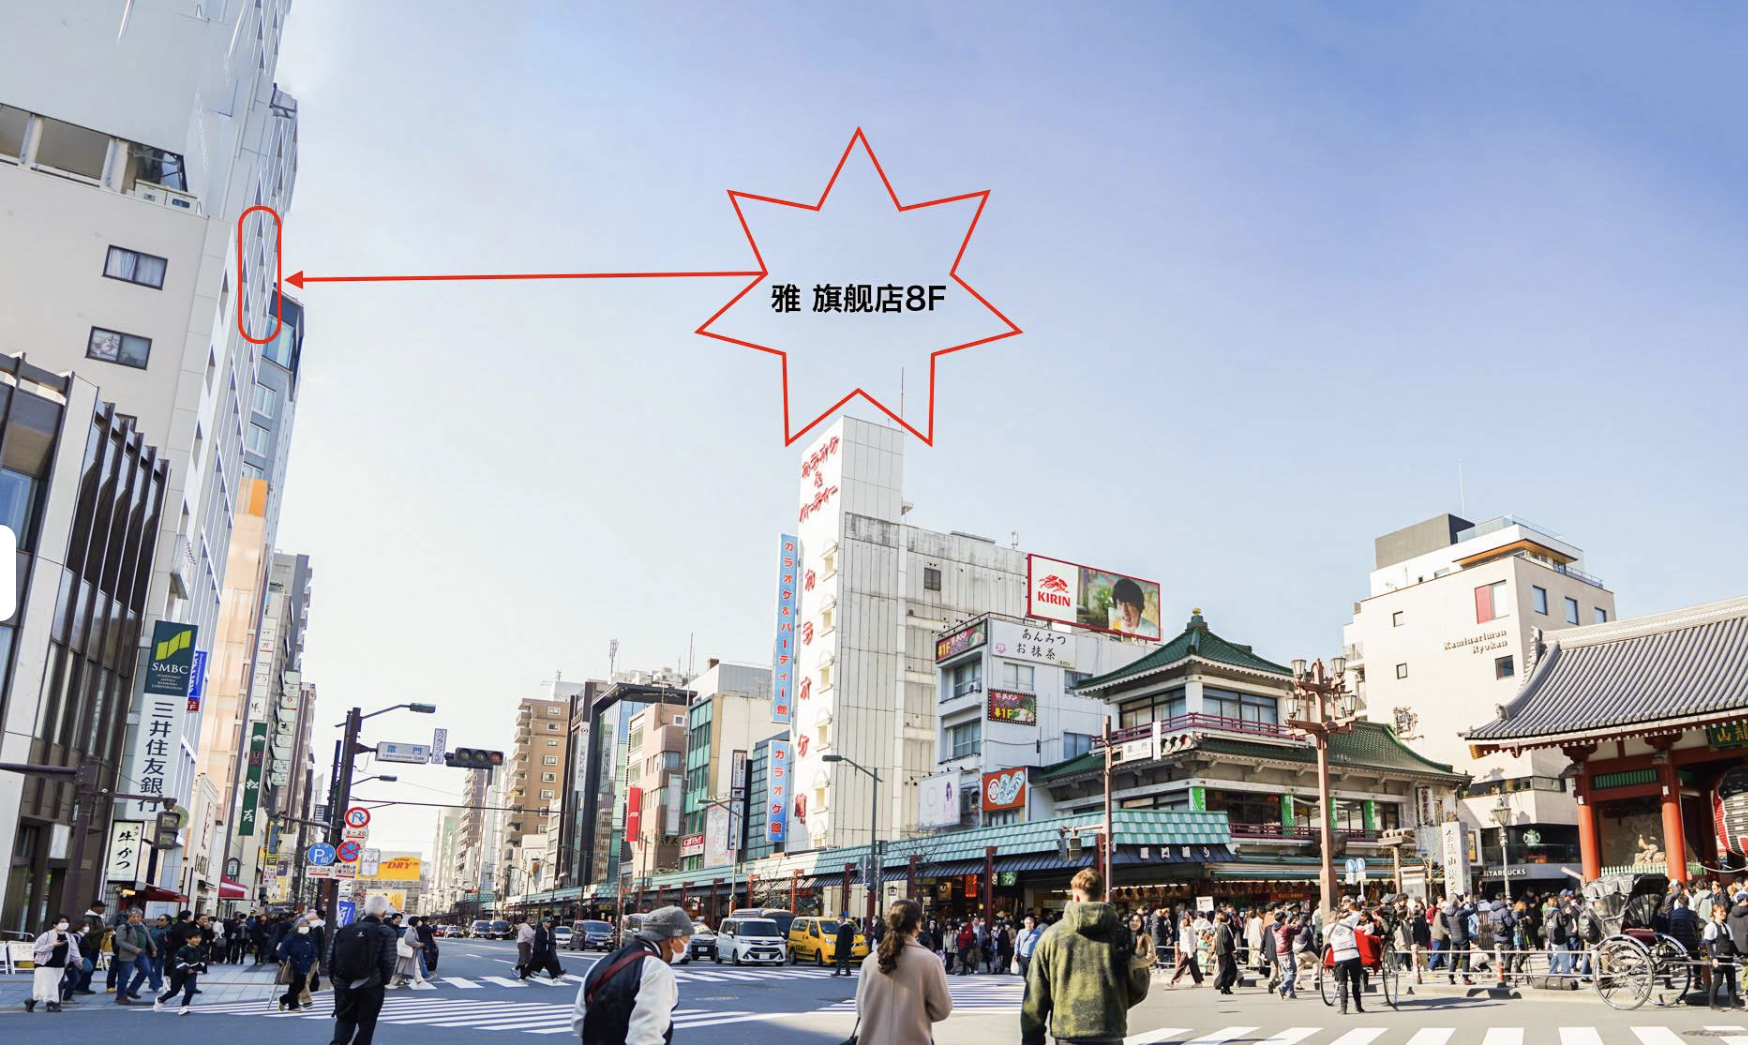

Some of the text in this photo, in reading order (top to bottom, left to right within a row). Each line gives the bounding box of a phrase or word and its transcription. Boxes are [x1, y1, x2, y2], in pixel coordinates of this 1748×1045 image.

[801, 435, 840, 479] カラオケ
[799, 485, 839, 524] パーティー
[1037, 591, 1071, 608] KIRIN
[1022, 628, 1067, 645] あんみつ
[1444, 630, 1508, 650] Kaminarimon
[1017, 642, 1056, 660] お抹茶
[1472, 640, 1509, 654] Ryokan
[151, 662, 189, 675] SMBC
[137, 701, 175, 813] 三井住友銀行
[770, 749, 785, 834] カラオケ館
[116, 830, 135, 871] 牛かつ
[313, 848, 325, 863] P
[1484, 868, 1526, 877] STARUCKS
